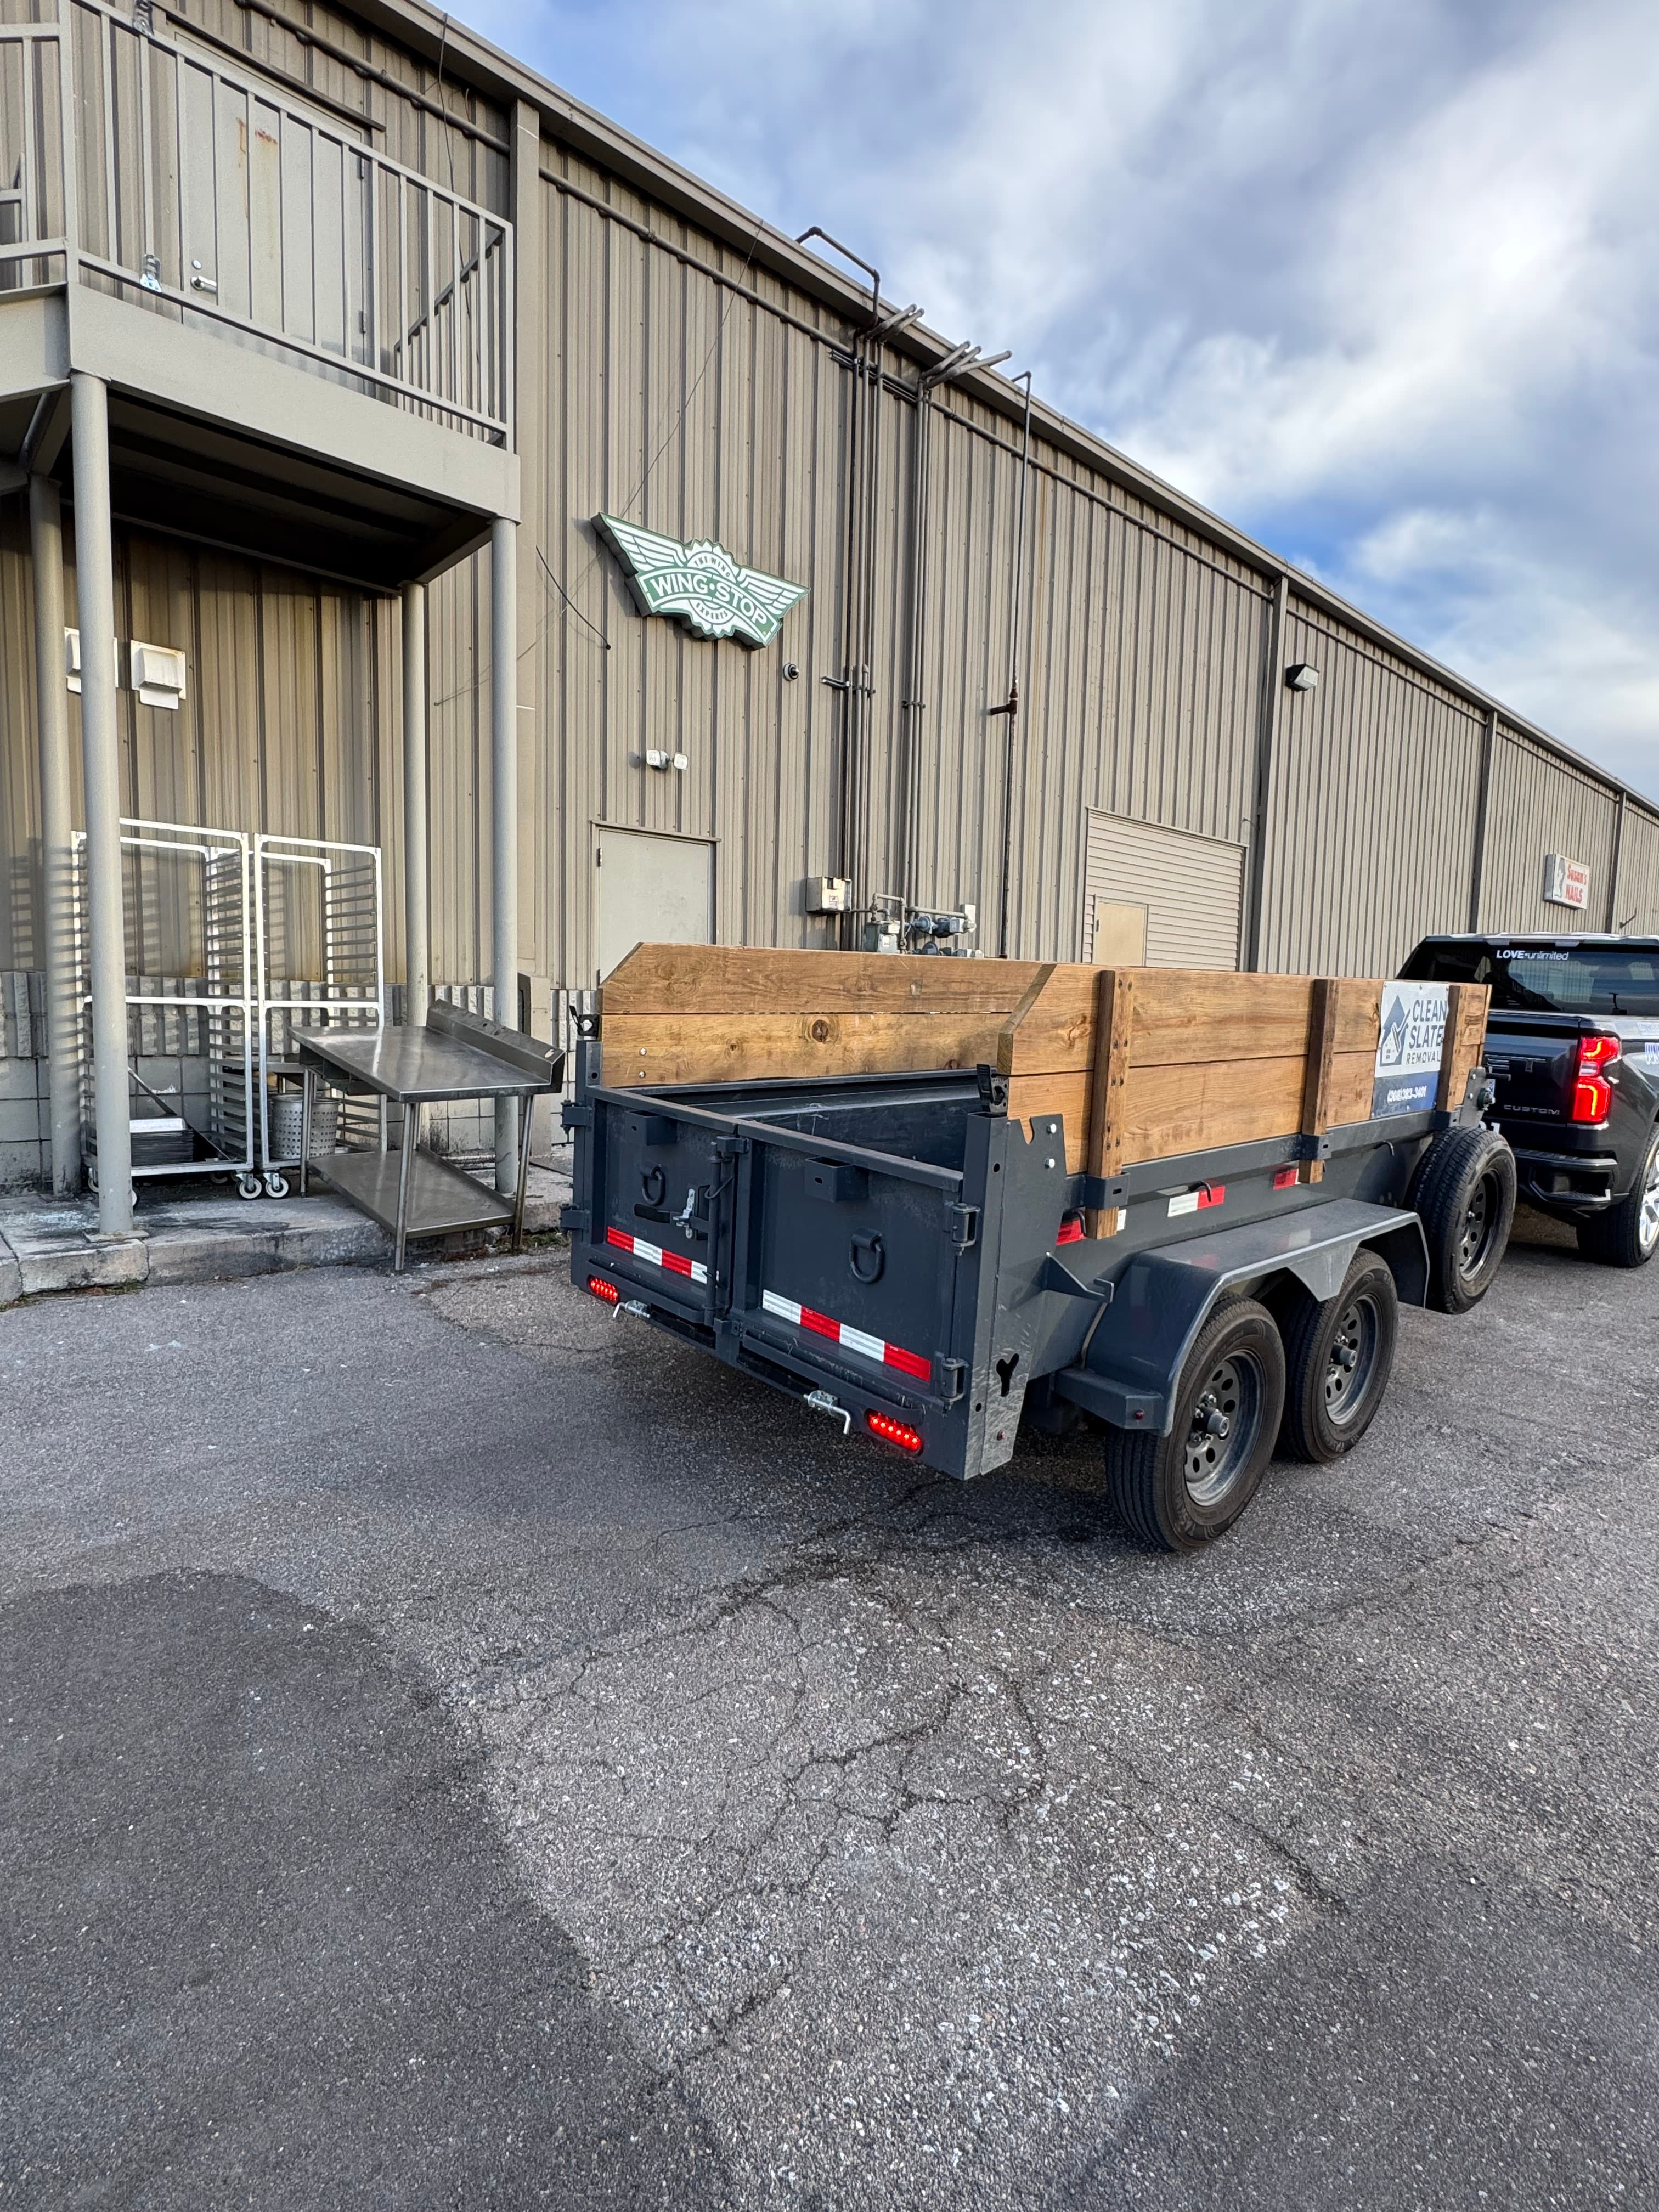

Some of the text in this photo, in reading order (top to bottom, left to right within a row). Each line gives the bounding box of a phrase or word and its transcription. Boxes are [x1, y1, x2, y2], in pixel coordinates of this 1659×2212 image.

[696, 602, 728, 620] EXPERTS
[1565, 884, 1583, 904] NAILS
[1412, 999, 1447, 1023] CLEAN
[1408, 1024, 1444, 1049] SLATE
[1504, 1104, 1560, 1115] CUSTOM
